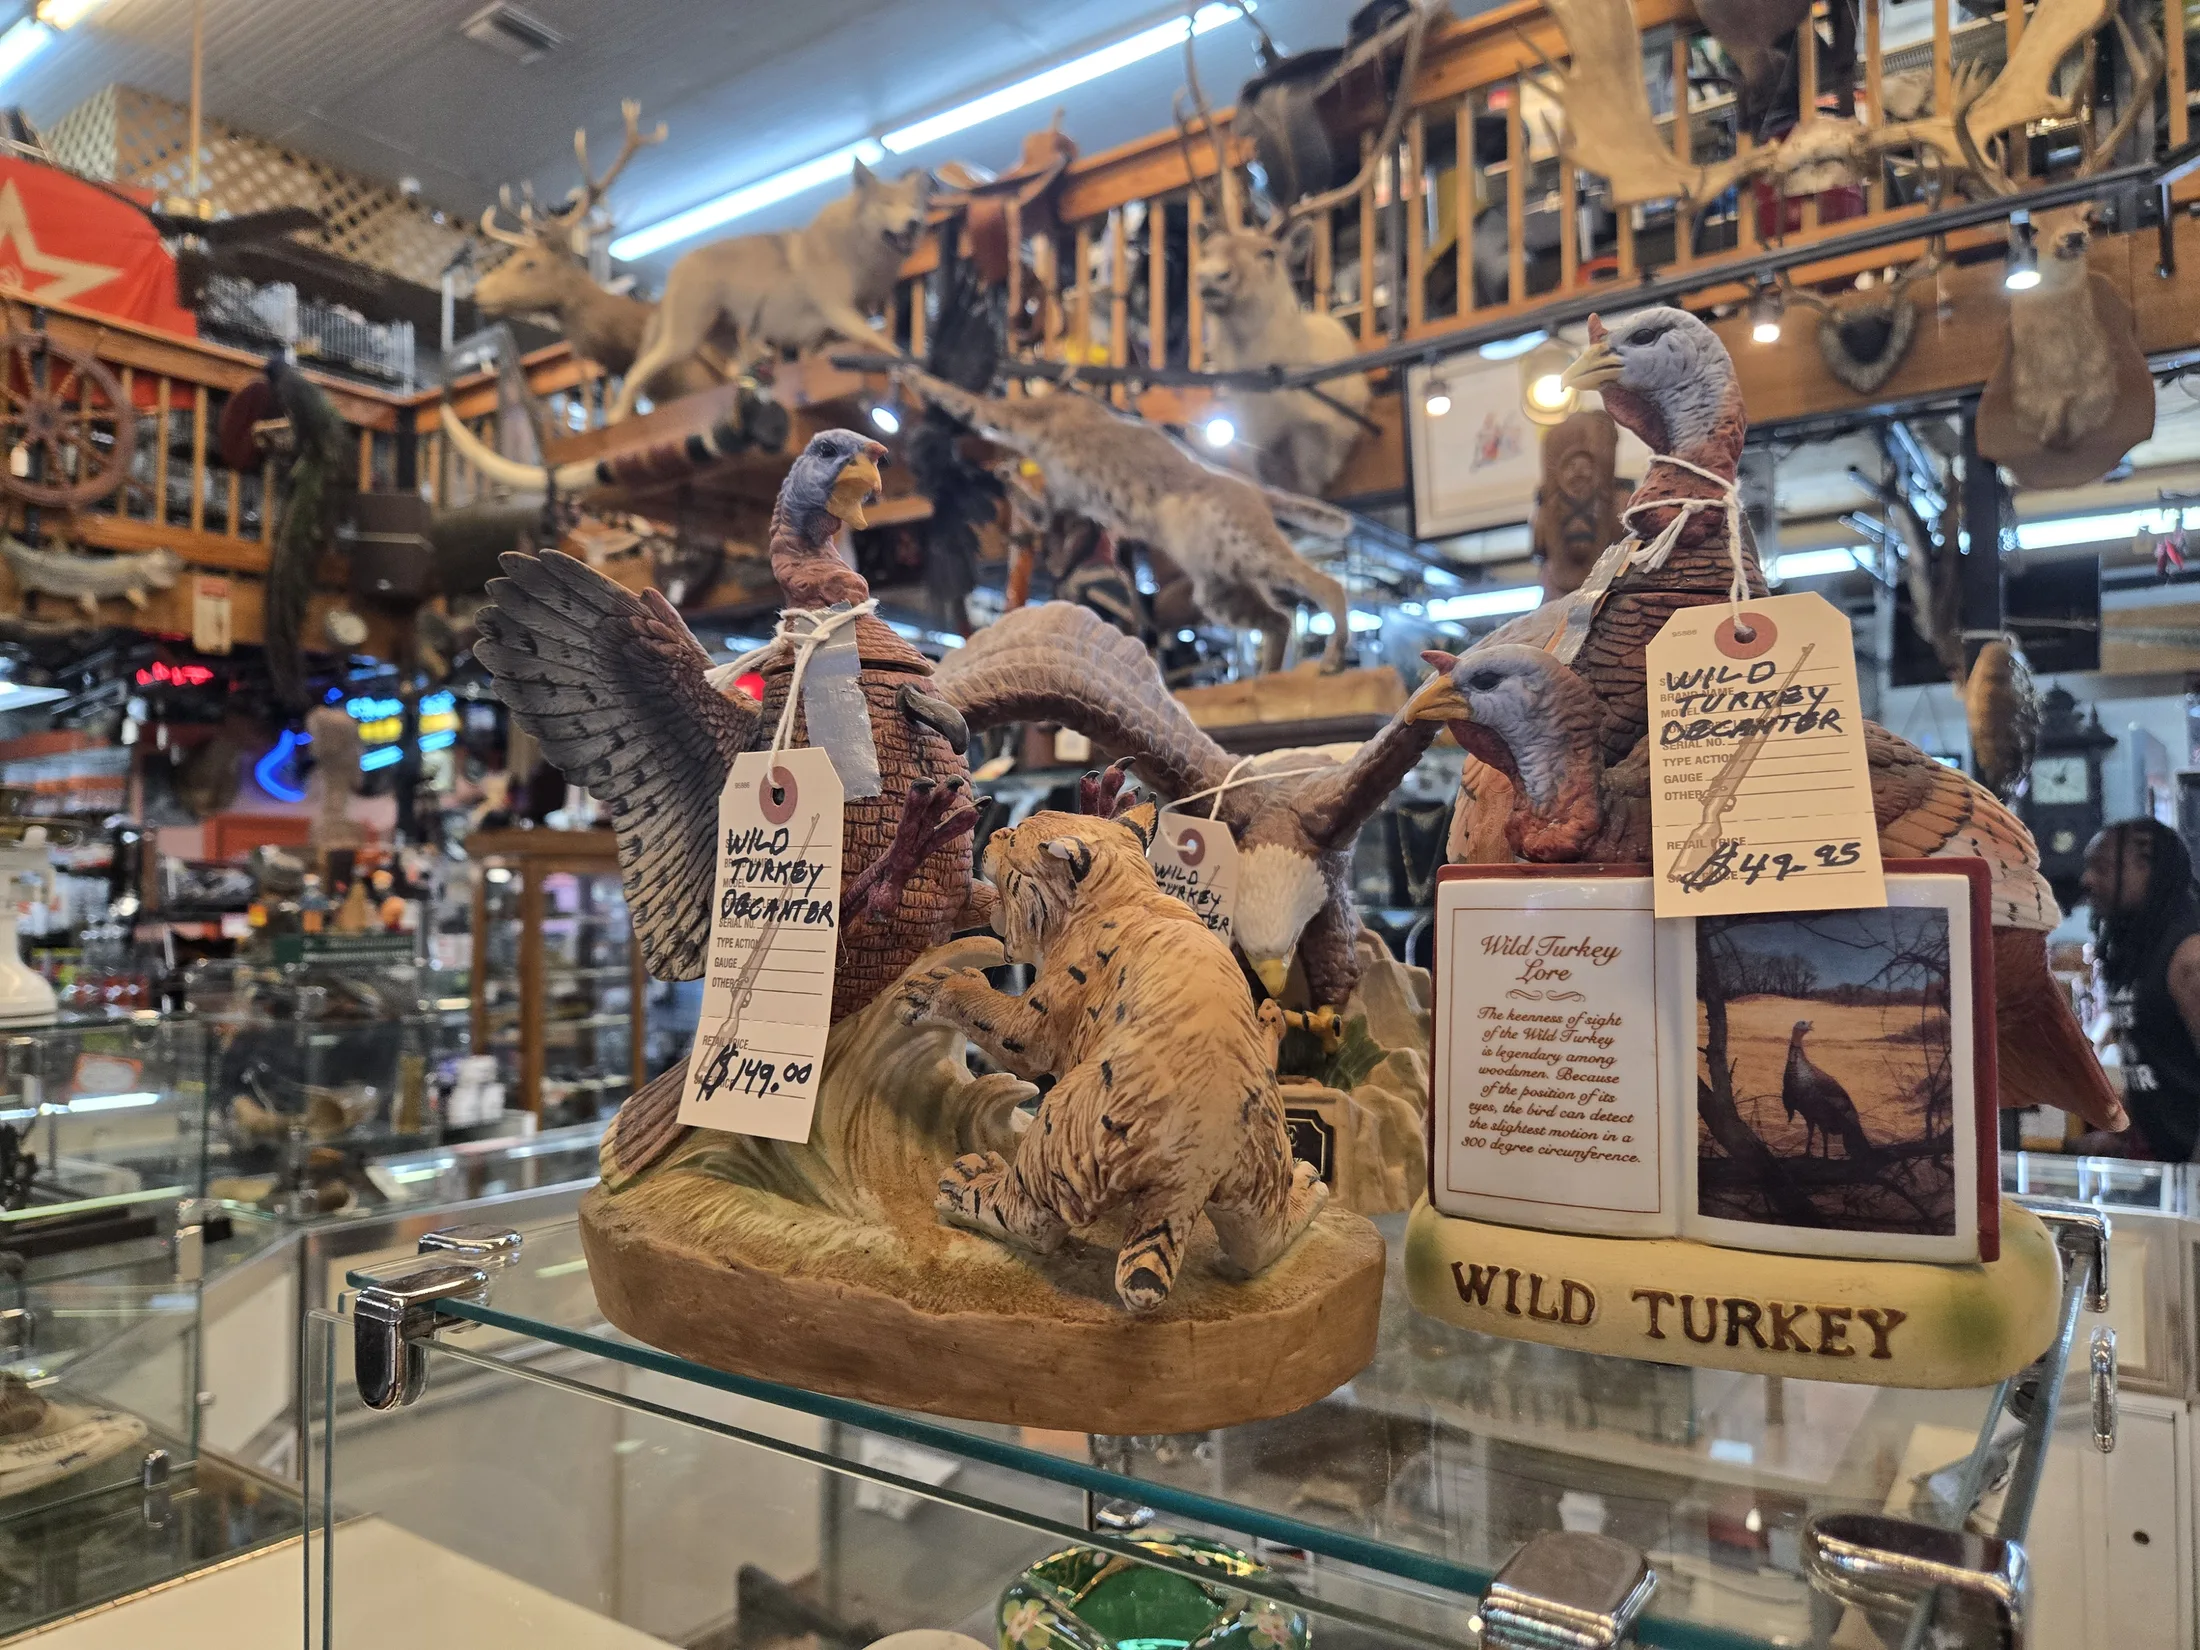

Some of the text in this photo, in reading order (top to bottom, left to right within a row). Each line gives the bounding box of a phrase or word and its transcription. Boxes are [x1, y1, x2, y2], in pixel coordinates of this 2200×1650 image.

[1666, 661, 1776, 691] WILD
[1660, 707, 1700, 718] MOEL
[1675, 685, 1829, 717] TURKEY
[1660, 708, 1844, 746] DECANTER
[1662, 737, 1726, 751] SERIAL NO.
[1662, 753, 1735, 768] TYPE ACTION
[1663, 773, 1703, 784] GAUGE
[1664, 790, 1703, 801] OTHER
[727, 827, 789, 855] WILD
[1666, 840, 1707, 851] RETAIL
[731, 857, 824, 897] TURKEY
[1154, 862, 1199, 885] WILD
[721, 889, 835, 927] DECANTER
[719, 917, 756, 929] SERIAL NO.
[717, 937, 760, 951] TYPE ACTION
[1481, 935, 1622, 966] Wild Turkey
[714, 957, 738, 969] GAUGE
[1515, 959, 1573, 984] Lore
[711, 976, 738, 989] OTHER
[1477, 1007, 1622, 1030] The keenness of sight
[702, 1035, 725, 1048] RETAIL
[1482, 1025, 1615, 1049] of the Wild Turkey
[1482, 1045, 1618, 1069] is legendary among
[696, 1043, 813, 1102] $149.00
[1478, 1064, 1620, 1084] woodsmen. Because
[1480, 1081, 1618, 1105] of the position of its
[1468, 1100, 1635, 1123] eyes, the bird can detect
[1468, 1117, 1635, 1143] the slightest motion in a
[1460, 1136, 1641, 1163] 300 degree circumference.
[1451, 1261, 1907, 1359] WILD TURKEY
